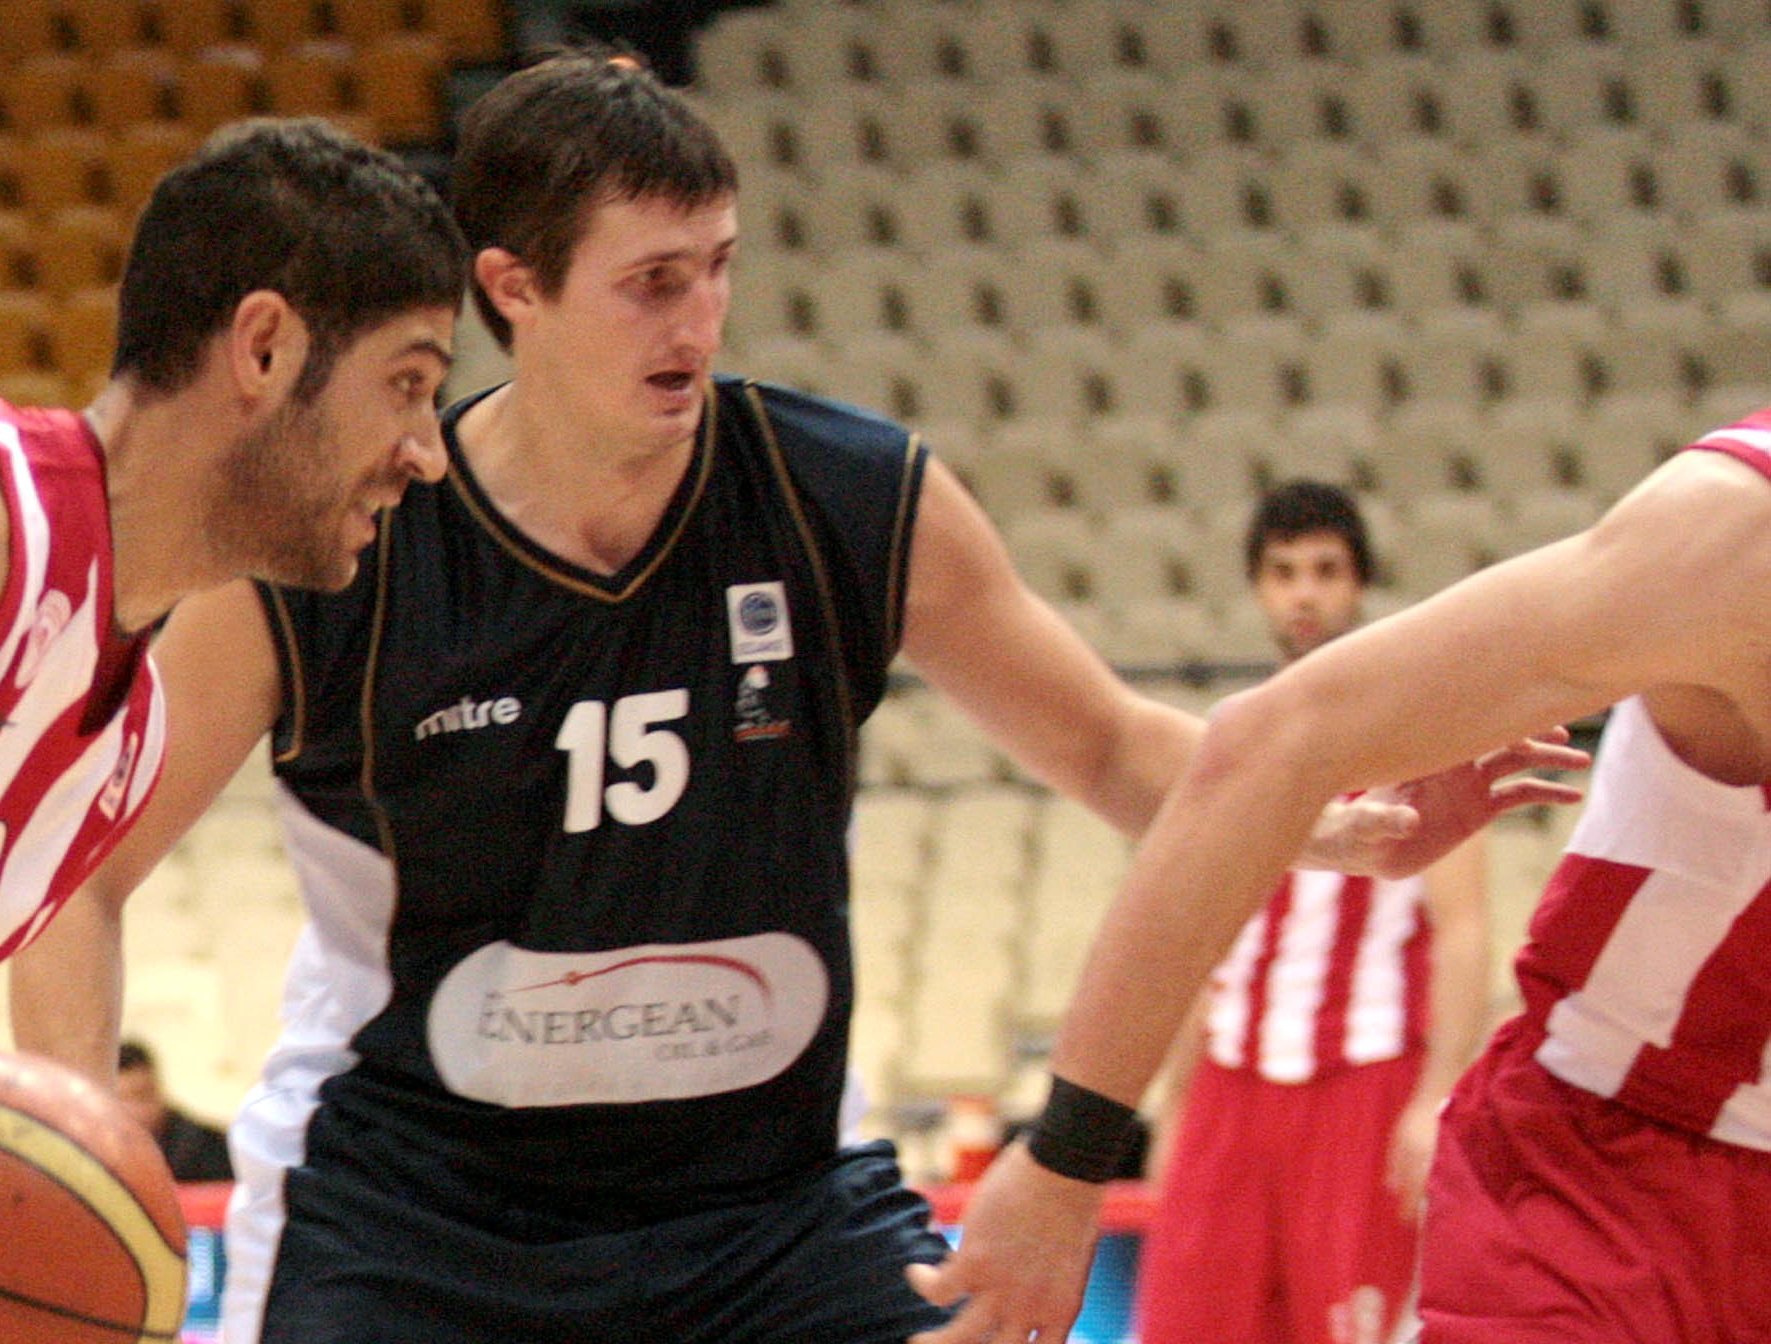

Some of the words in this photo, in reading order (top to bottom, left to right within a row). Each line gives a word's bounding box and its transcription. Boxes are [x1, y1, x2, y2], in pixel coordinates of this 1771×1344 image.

[414, 696, 522, 740] mitre
[554, 688, 690, 834] 15
[478, 990, 740, 1044] ENERGEAN
